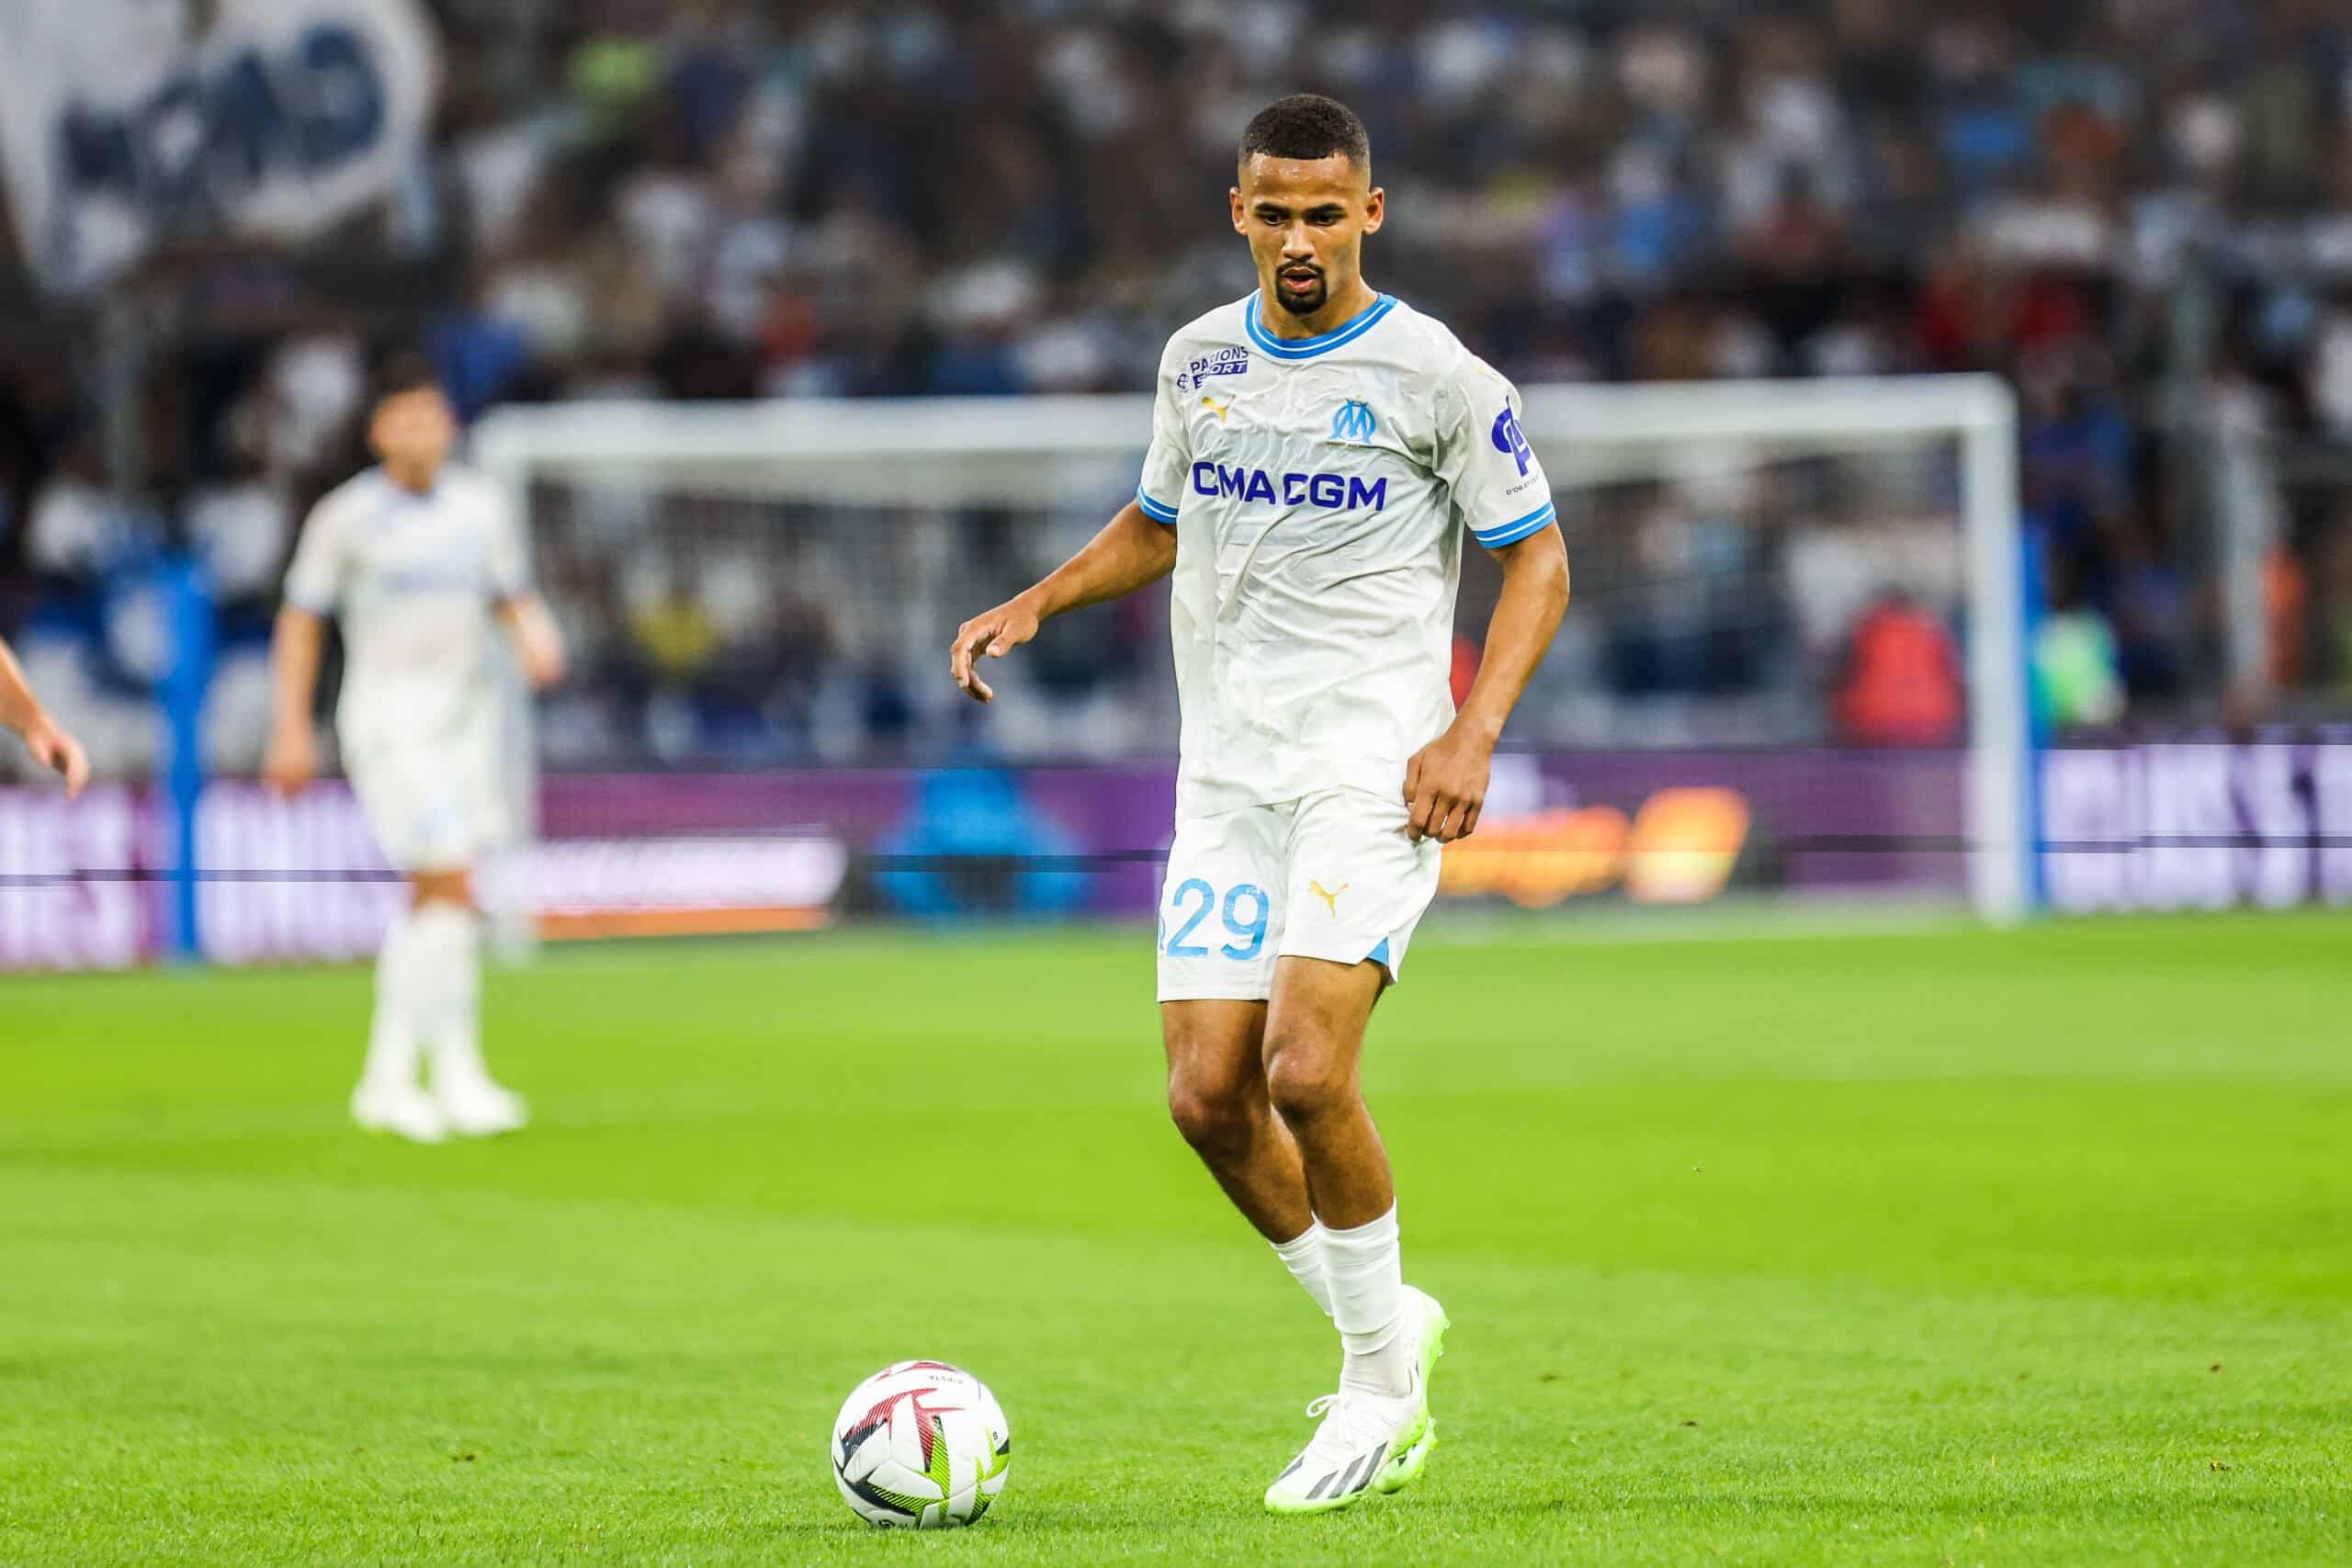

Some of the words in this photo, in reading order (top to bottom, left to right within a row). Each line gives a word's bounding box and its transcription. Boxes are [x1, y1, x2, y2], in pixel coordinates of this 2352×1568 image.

[1193, 461, 1276, 505] CMA
[1283, 473, 1387, 512] CGM
[1167, 878, 1269, 961] 29
